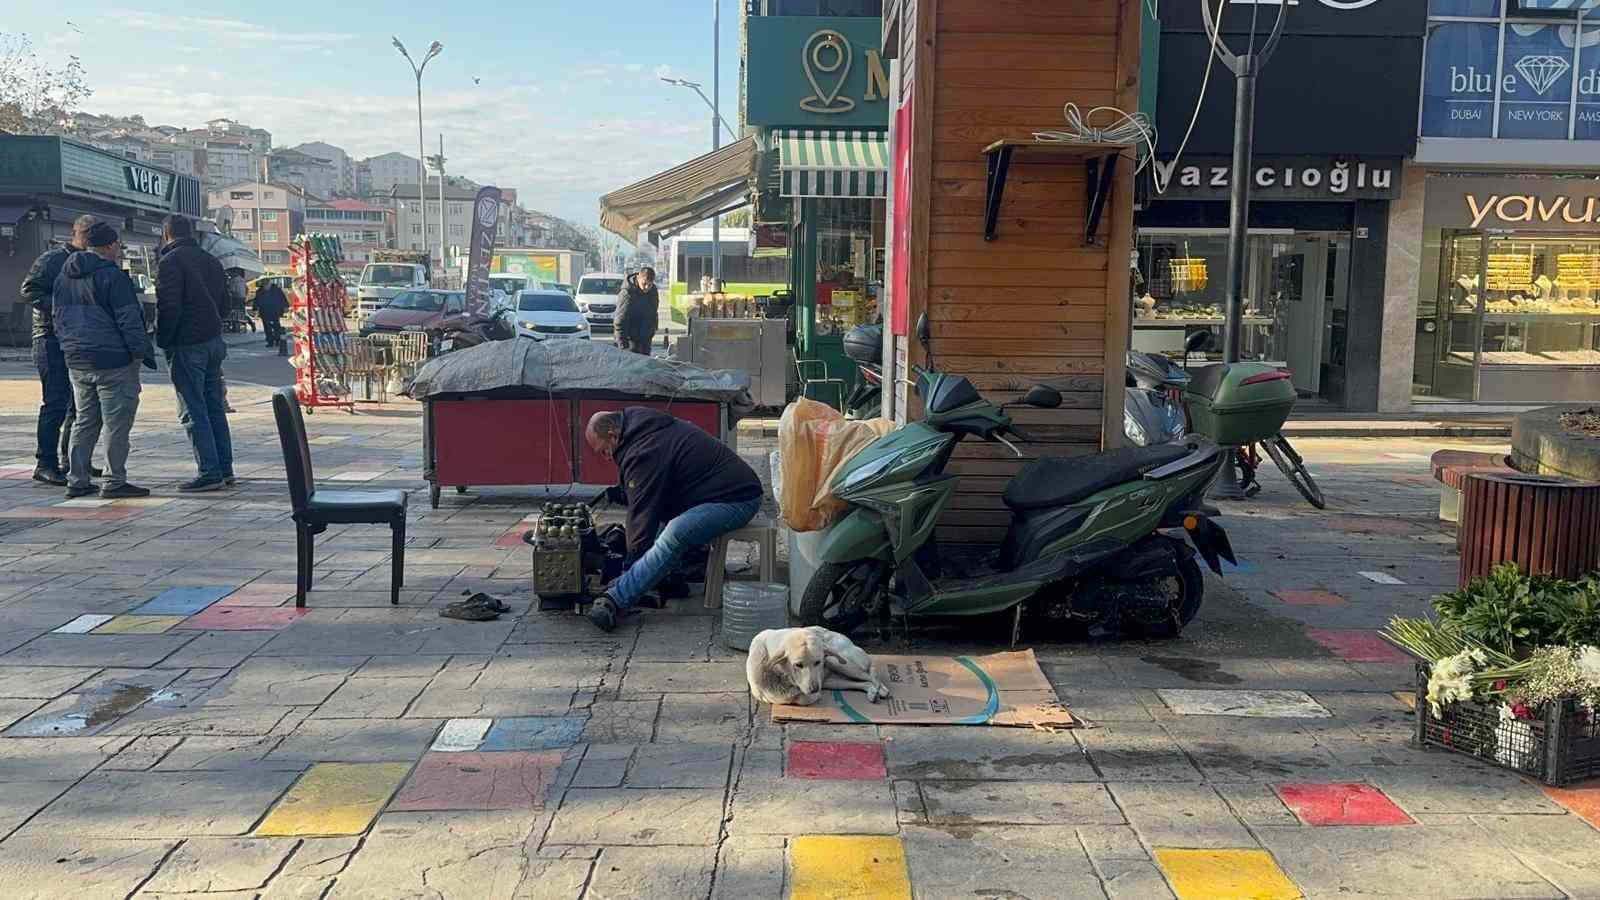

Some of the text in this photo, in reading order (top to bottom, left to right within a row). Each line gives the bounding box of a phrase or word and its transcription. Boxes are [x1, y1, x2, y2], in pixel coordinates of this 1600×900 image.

[1451, 110, 1481, 120] DUBAI
[1154, 160, 1392, 193] Yazcıoğlu
[1466, 194, 1600, 228] yavu
